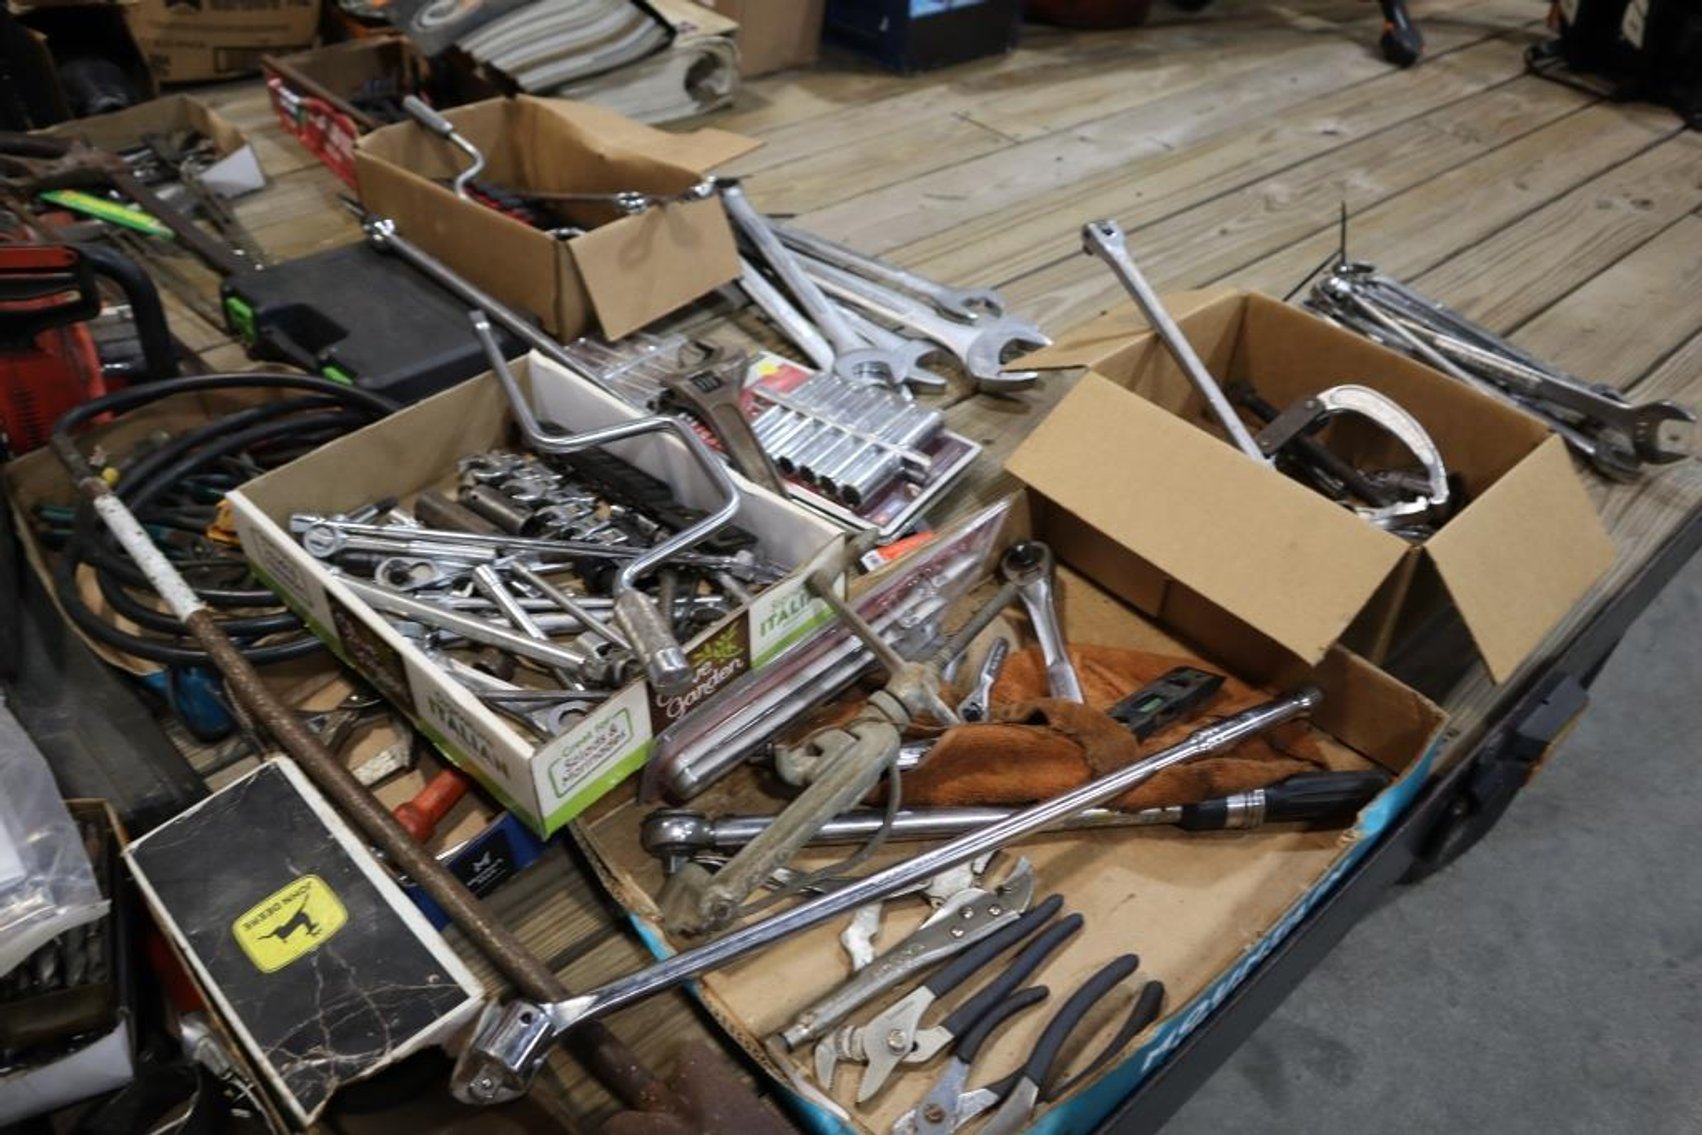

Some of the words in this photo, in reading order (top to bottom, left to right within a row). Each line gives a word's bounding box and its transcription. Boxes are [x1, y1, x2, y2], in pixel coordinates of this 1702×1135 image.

[666, 658, 744, 719] Garden
[282, 881, 312, 905] JOHN
[242, 902, 281, 931] DEERE
